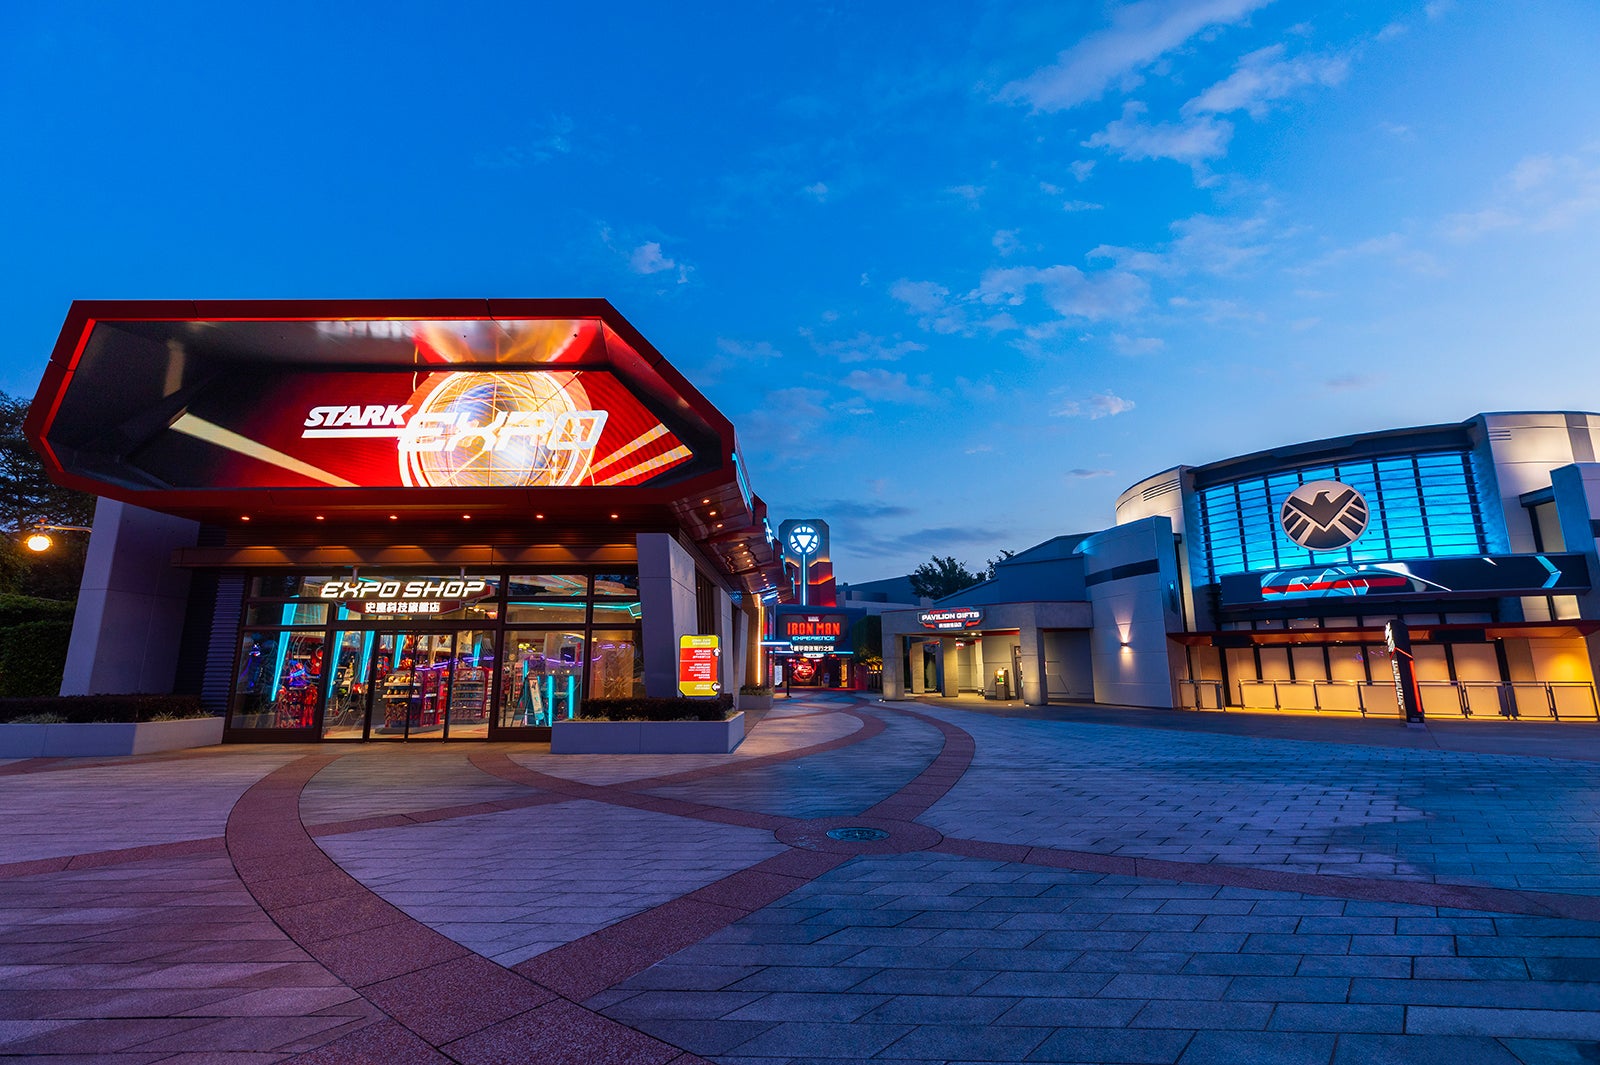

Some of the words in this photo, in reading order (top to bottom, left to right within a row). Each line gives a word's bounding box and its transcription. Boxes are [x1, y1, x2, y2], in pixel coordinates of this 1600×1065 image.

[303, 405, 413, 427] STARK
[398, 410, 609, 452] EXPO
[321, 581, 400, 598] EXPO
[402, 581, 486, 598] SHOP
[921, 612, 956, 621] PAVILION
[956, 611, 980, 619] GIFTS
[787, 622, 814, 636] IRON
[815, 622, 840, 636] MAN
